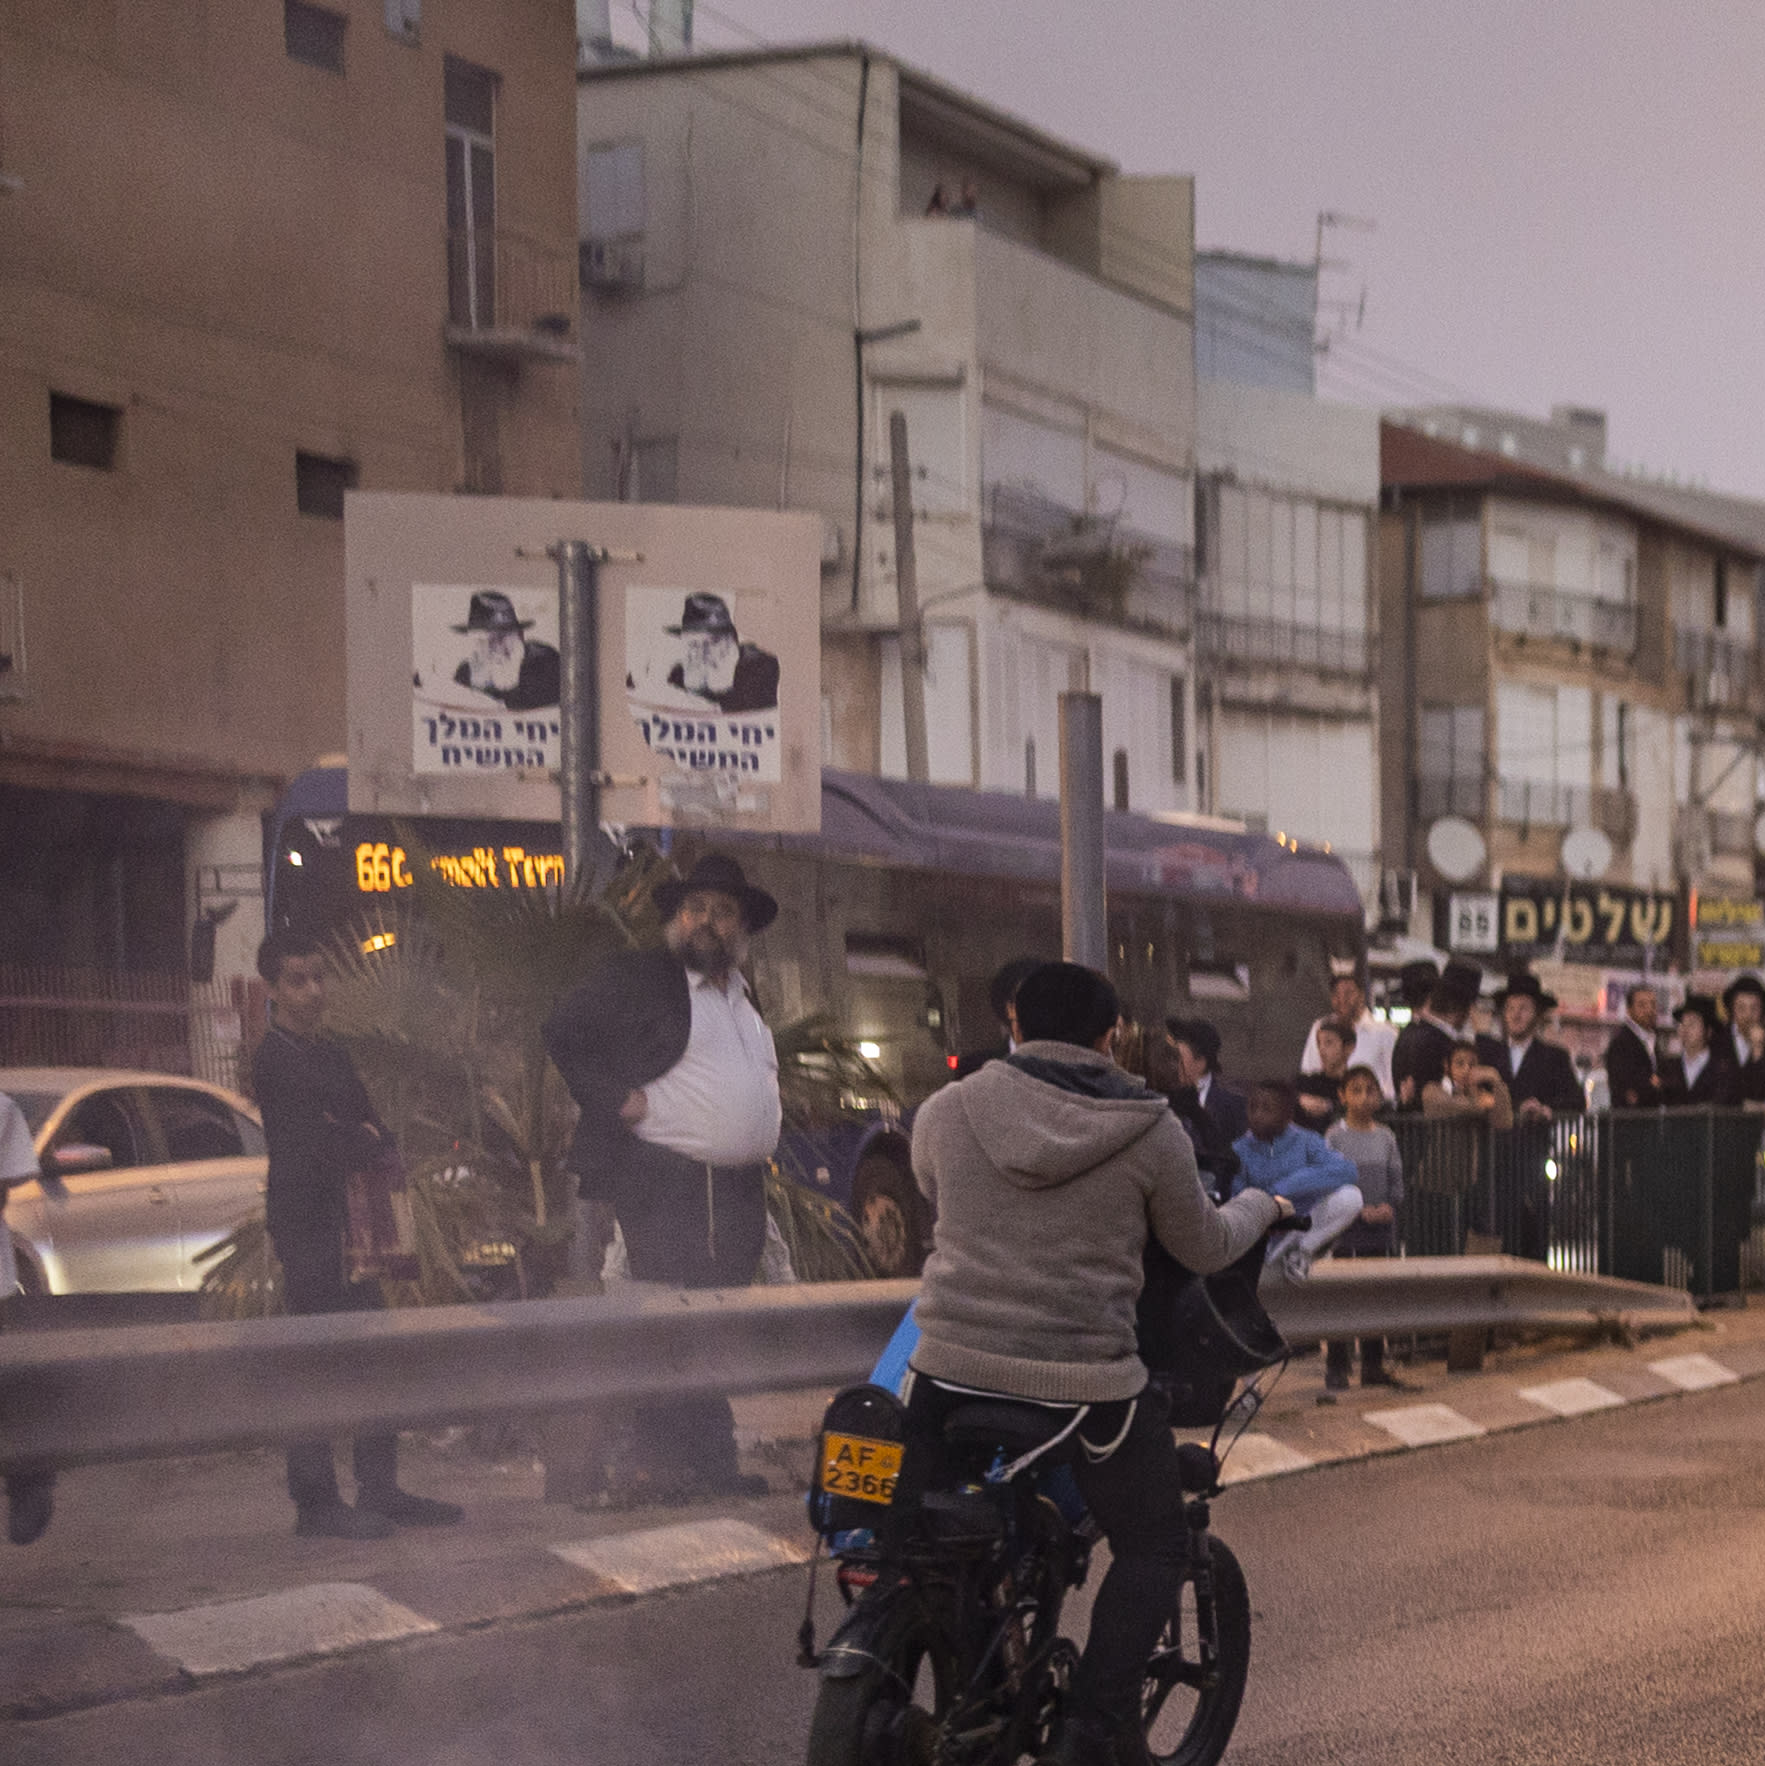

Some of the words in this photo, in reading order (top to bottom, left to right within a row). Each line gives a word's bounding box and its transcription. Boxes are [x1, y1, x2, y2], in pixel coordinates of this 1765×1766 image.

[423, 713, 502, 746] המלך
[514, 720, 560, 743] יחי
[729, 725, 775, 745] יחי
[441, 745, 545, 768] המשיח
[1504, 893, 1673, 944] שלטים
[836, 1443, 876, 1468] AF
